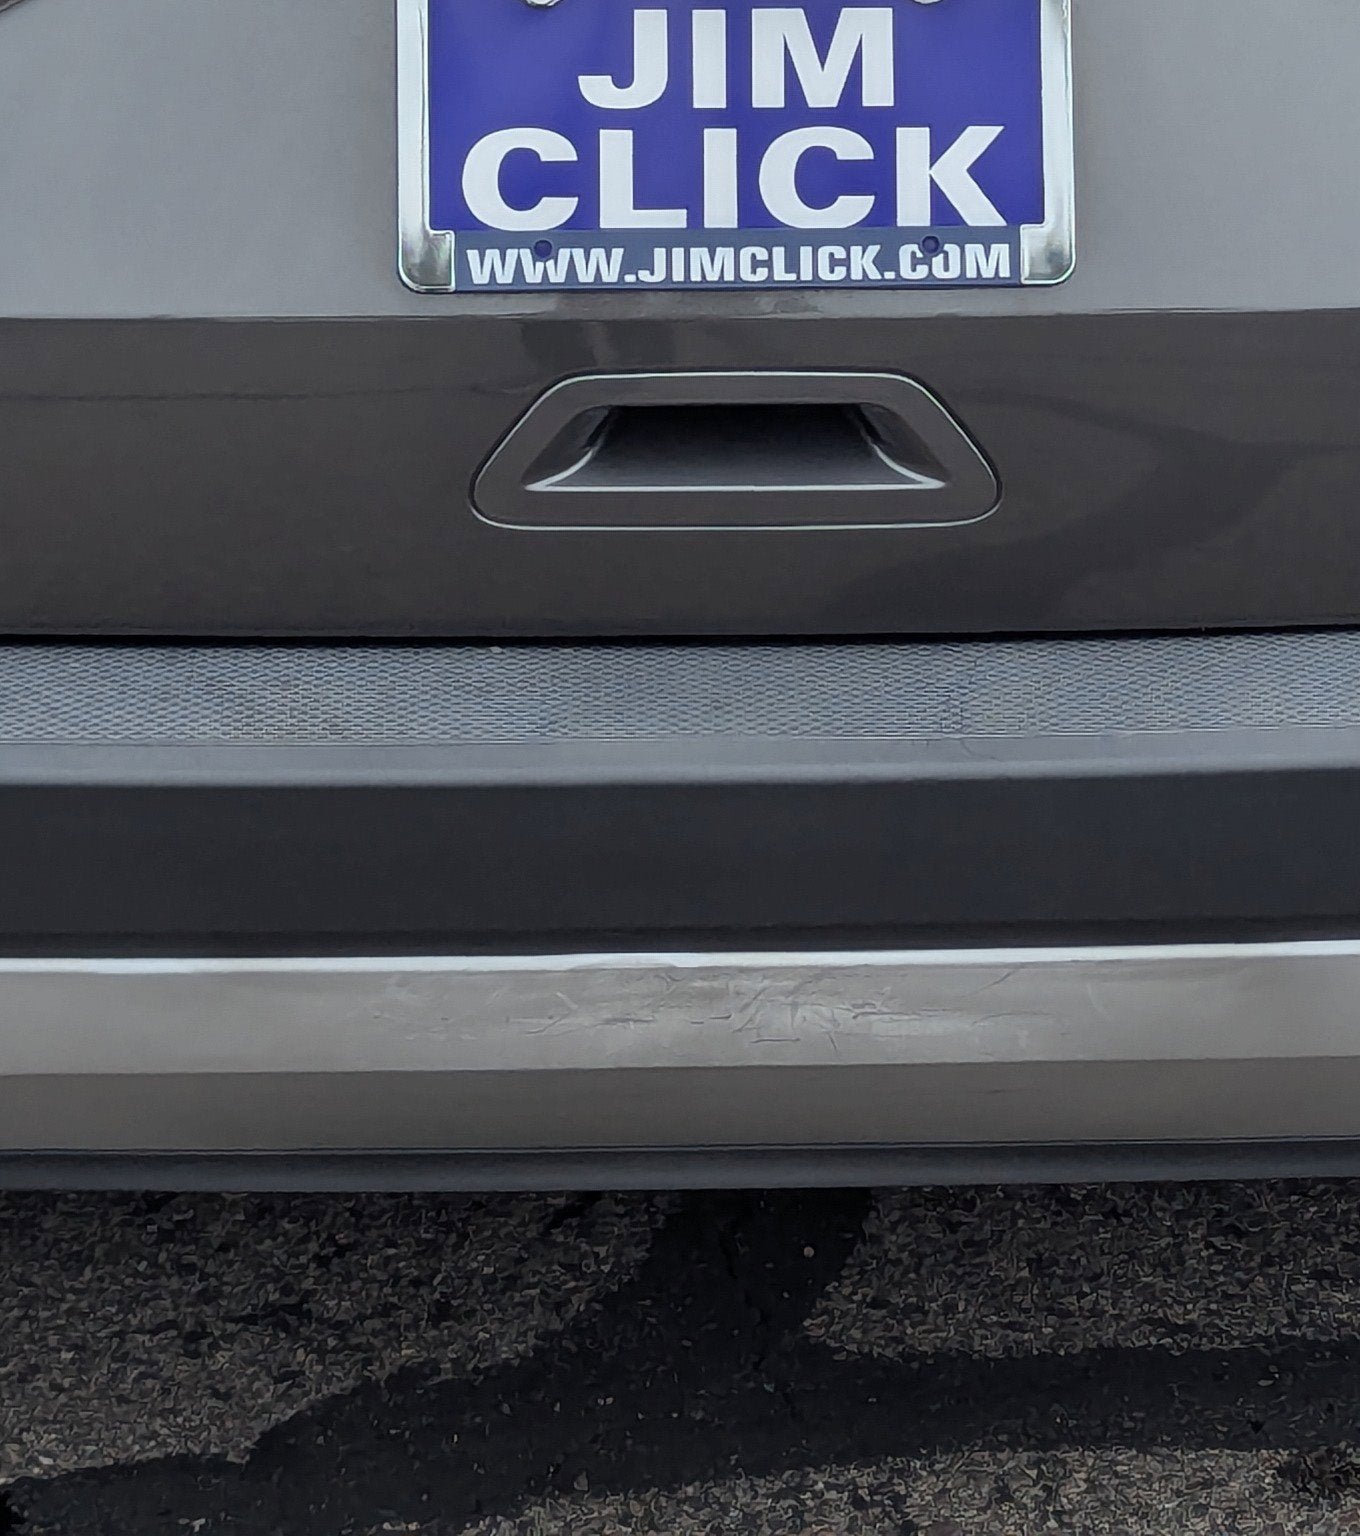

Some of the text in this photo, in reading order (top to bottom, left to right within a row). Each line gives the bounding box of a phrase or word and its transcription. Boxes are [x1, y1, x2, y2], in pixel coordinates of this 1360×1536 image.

[578, 7, 895, 110] JIM
[461, 125, 1006, 232] CLICK
[466, 243, 1011, 285] WWW.JIMCLICK.COM
